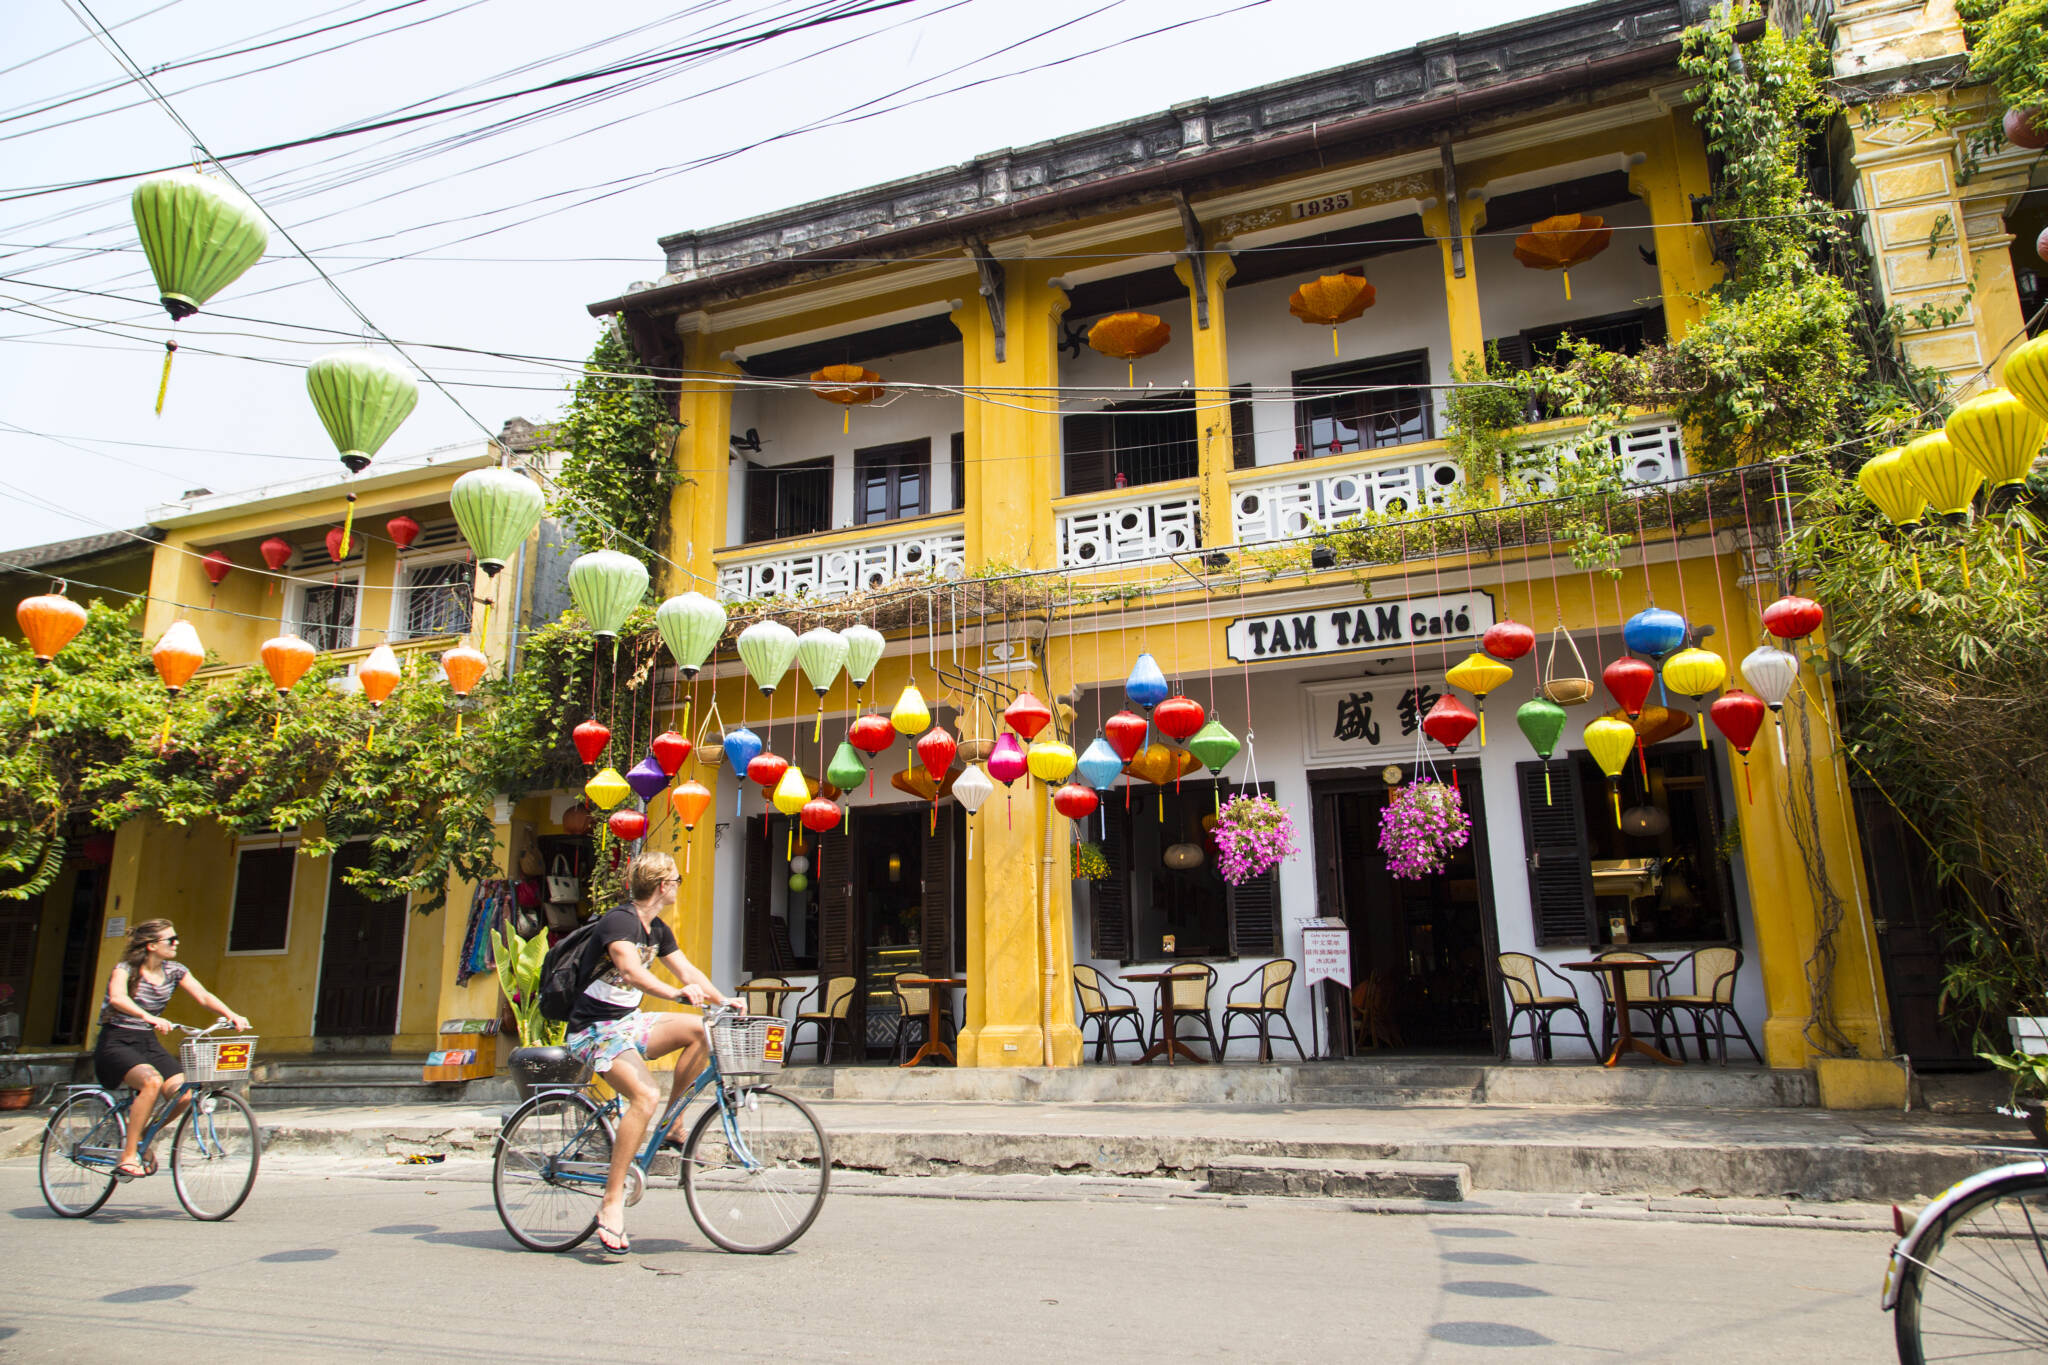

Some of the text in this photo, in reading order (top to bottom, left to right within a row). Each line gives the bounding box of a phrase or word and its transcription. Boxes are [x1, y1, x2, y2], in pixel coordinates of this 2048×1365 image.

[1297, 194, 1349, 217] 1935
[1248, 605, 1471, 655] TAM TAM Café
